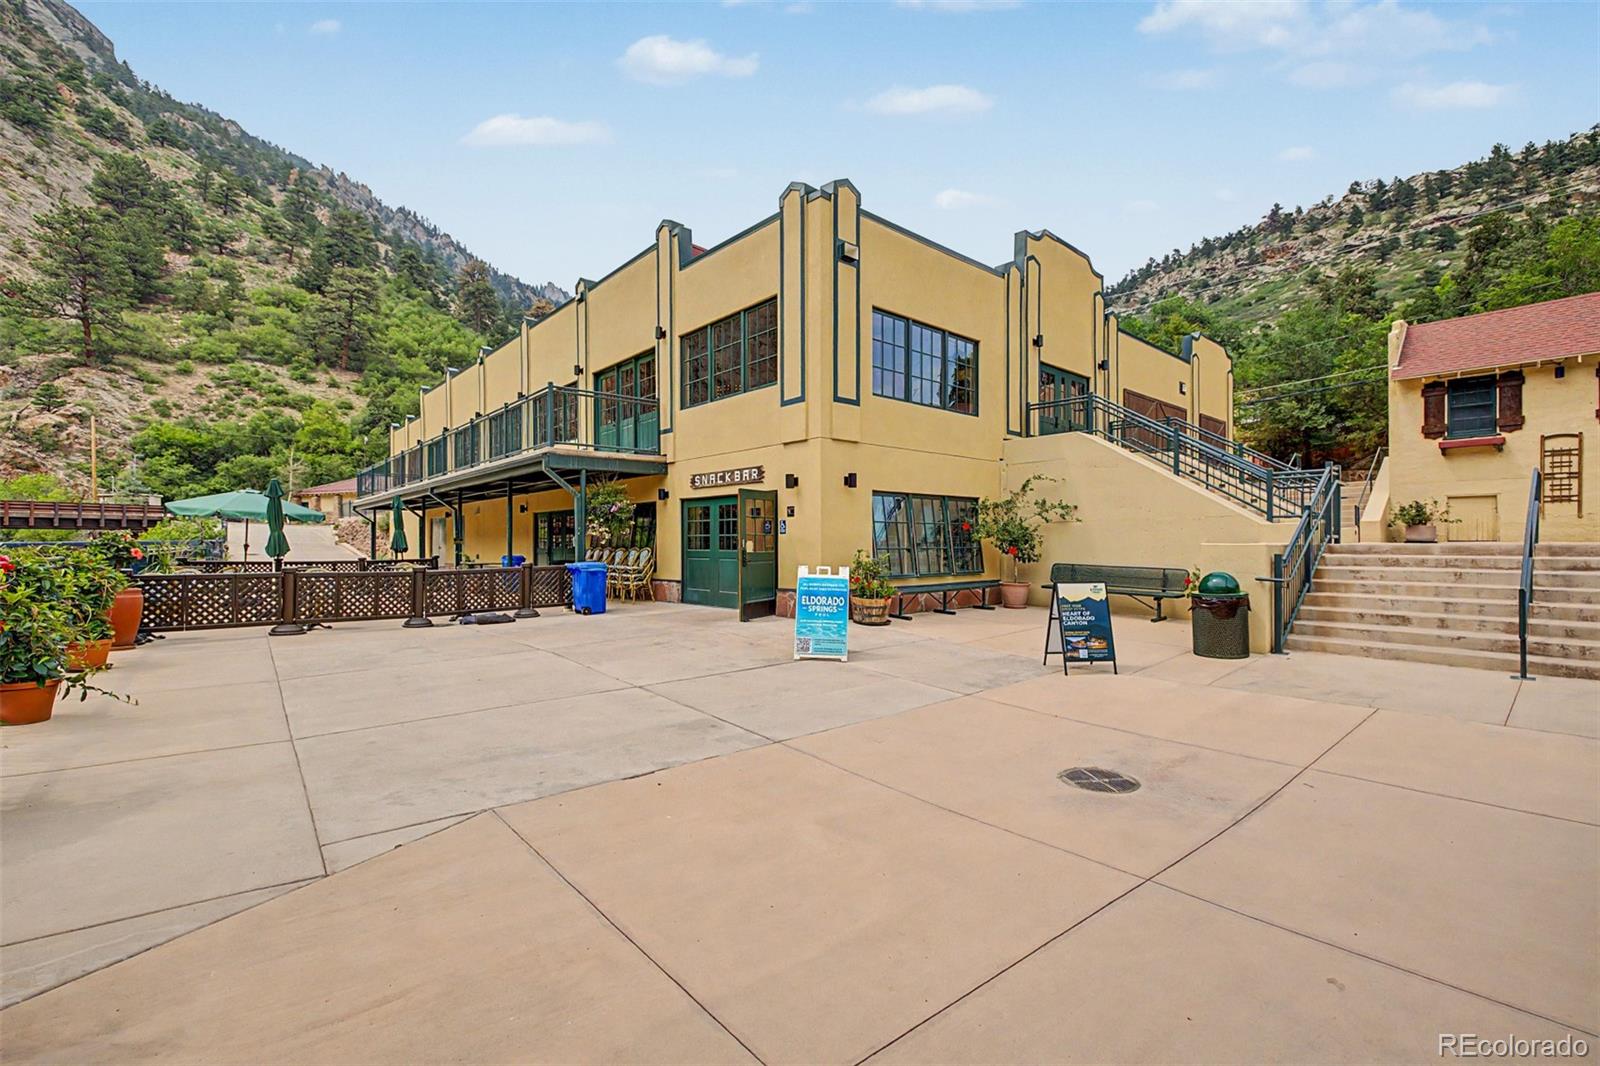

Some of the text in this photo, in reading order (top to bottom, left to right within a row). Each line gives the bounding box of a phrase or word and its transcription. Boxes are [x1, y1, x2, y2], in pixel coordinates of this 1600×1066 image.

[694, 468, 758, 486] SNACK BAR
[801, 596, 844, 606] ELDORADO
